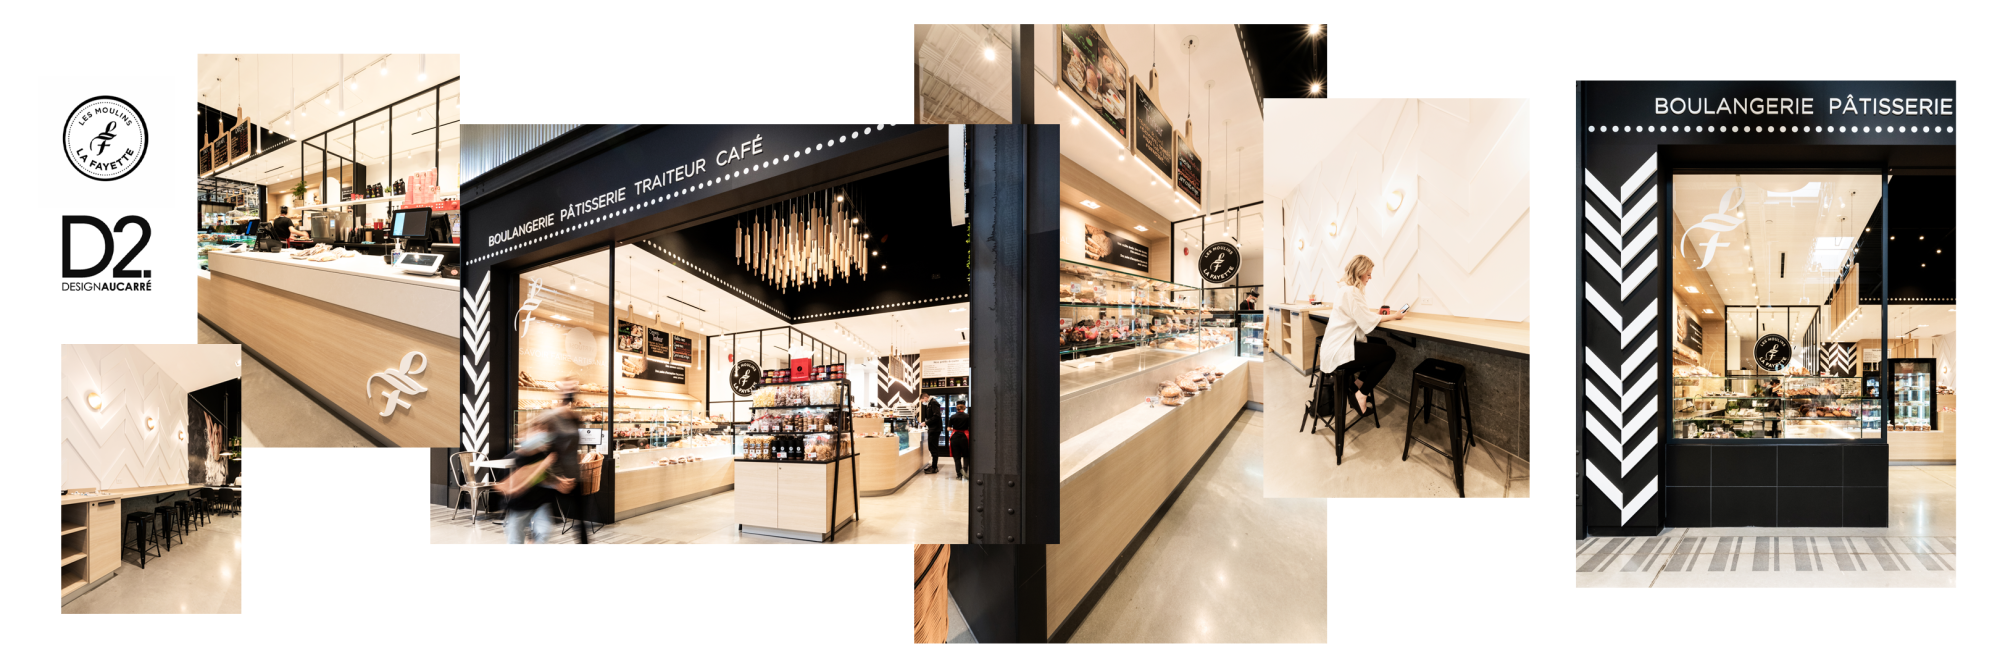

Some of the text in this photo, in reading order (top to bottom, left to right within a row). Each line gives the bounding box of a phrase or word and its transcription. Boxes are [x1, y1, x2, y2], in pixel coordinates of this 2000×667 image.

[1655, 94, 1953, 115] BOULANGERIE PÂTISSERIE
[488, 134, 763, 247] BOULANGERIE PÂTISSERIE TRAITEUR CAFÉ
[1204, 246, 1233, 258] LES MOULINS
[1203, 266, 1234, 280] LA FAYETTE
[1768, 337, 1786, 346] MOULINS
